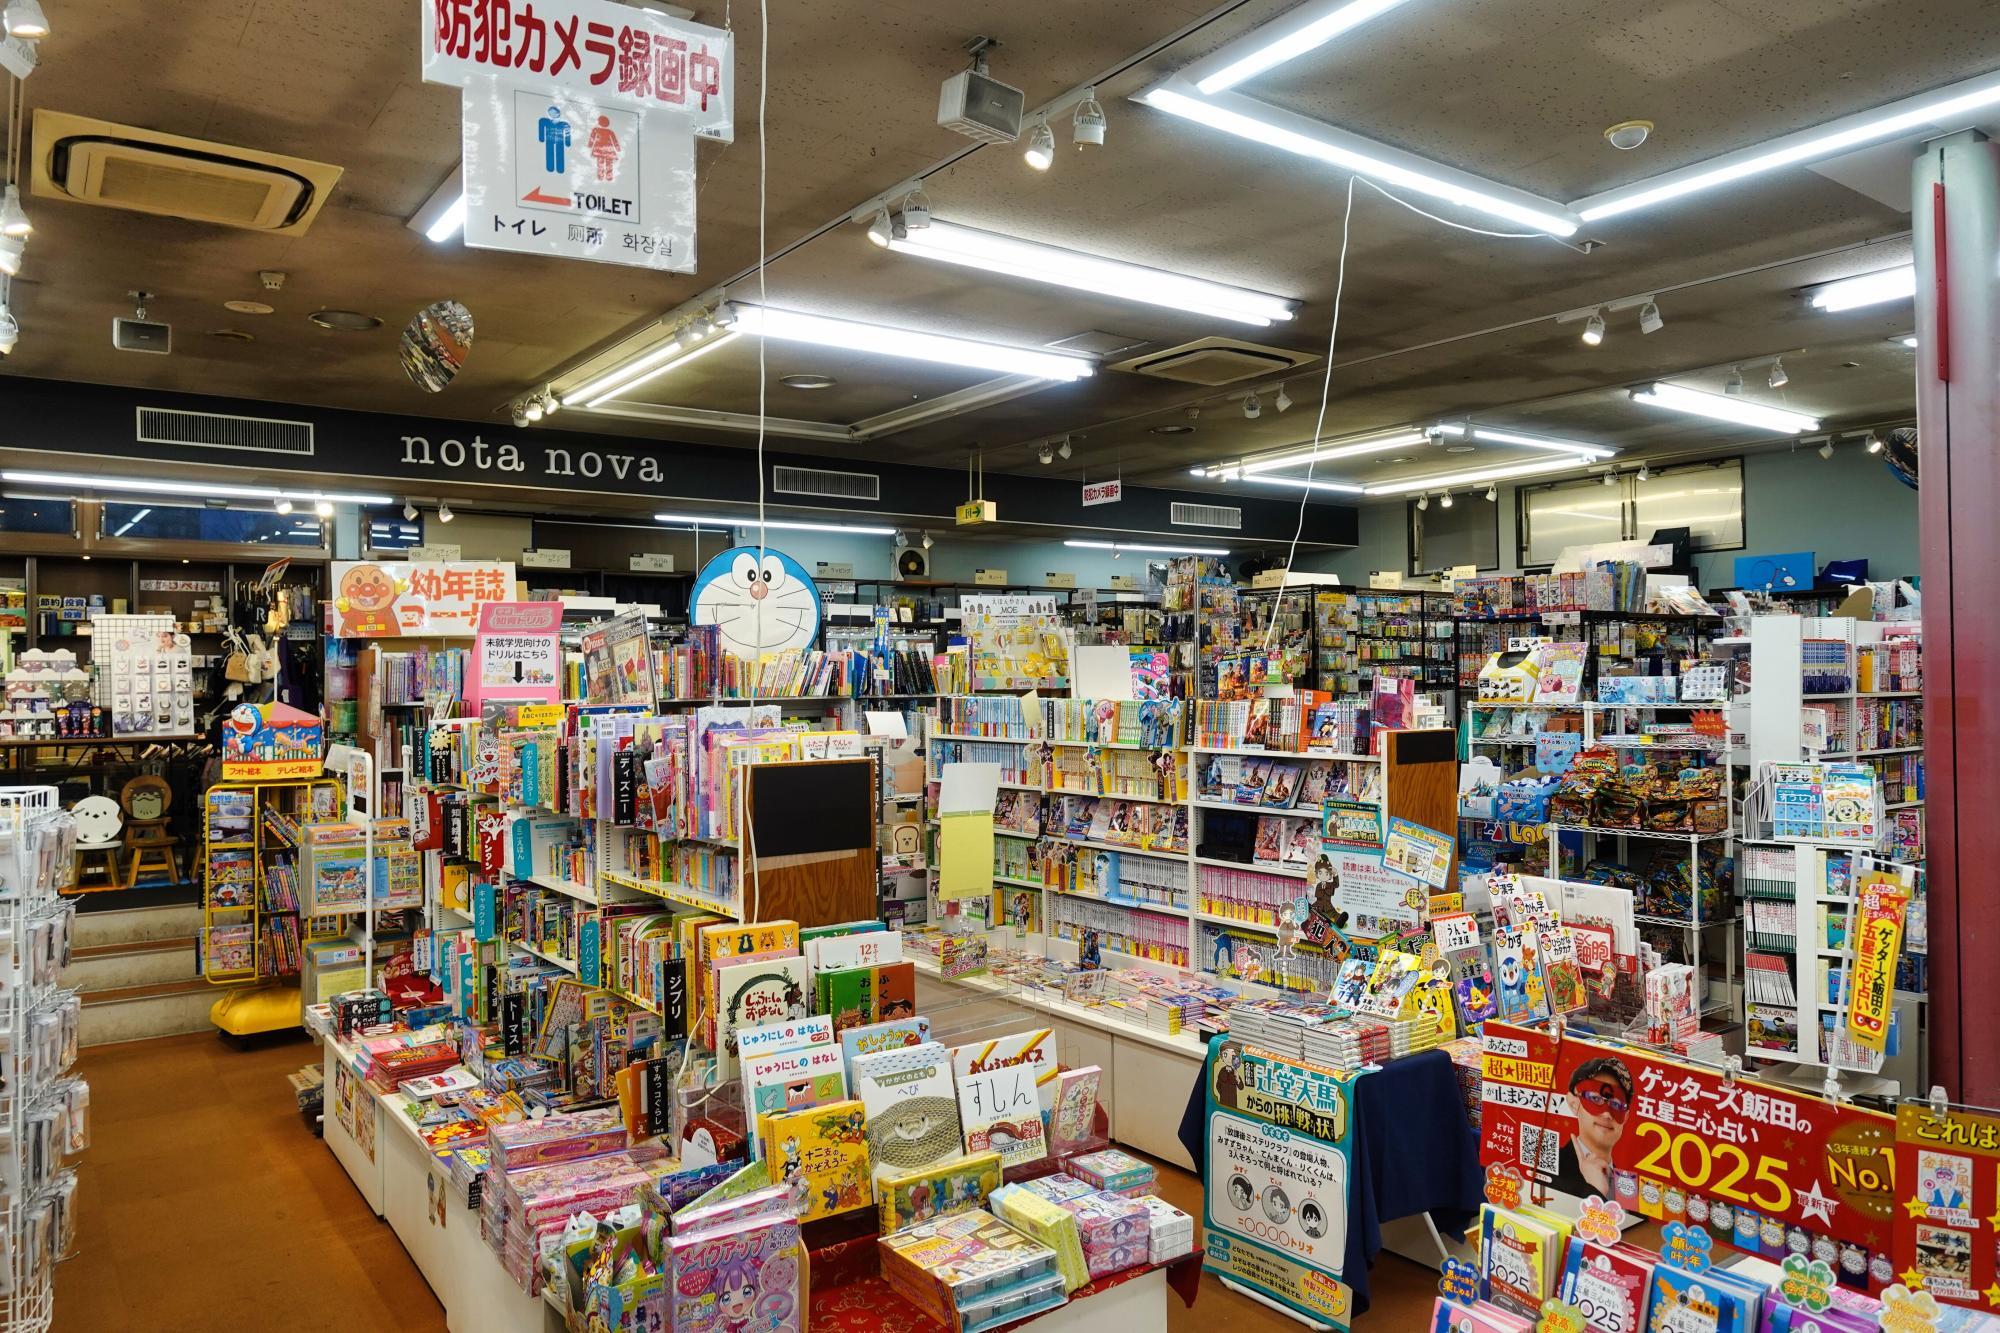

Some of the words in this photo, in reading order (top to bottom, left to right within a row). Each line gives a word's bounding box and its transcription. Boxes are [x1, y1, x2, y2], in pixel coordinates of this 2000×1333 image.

[434, 0, 720, 112] 防犯カメラ録画中
[573, 192, 632, 217] TOILET
[493, 214, 547, 237] トイレ
[621, 232, 673, 257] 화장실
[400, 435, 525, 472] nota
[544, 448, 664, 483] nova
[1083, 482, 1120, 501] 防犯カメラ録画中
[409, 568, 505, 602] 幼年誌
[39, 597, 61, 608] 節約
[64, 597, 86, 609] 投資
[991, 597, 1026, 606] えほんやさん
[1000, 606, 1018, 614] MOE
[62, 609, 84, 620] 投資
[485, 638, 551, 648] 未就学児向けの
[487, 650, 549, 660] ドリルはこちら
[228, 766, 262, 776] フォト絵本
[276, 765, 314, 775] テレビ絵本
[472, 765, 499, 781] ノンタン
[525, 748, 534, 798] ポケットモンスター
[619, 757, 630, 814] ディズニー
[516, 825, 525, 861] ミニえほん
[484, 837, 492, 871] ノンタン
[1342, 861, 1390, 876] 読書は楽しい。
[1499, 883, 1514, 895] 漢字
[1870, 884, 1895, 893] あなたの
[478, 890, 487, 934] キャラクター
[1524, 900, 1545, 914] かん字
[1310, 920, 1325, 941] 犯
[1447, 922, 1468, 935] うんこ
[1538, 920, 1559, 933] かん字
[859, 943, 872, 956] 12
[1551, 935, 1572, 948] ひらがな
[1553, 944, 1572, 956] カタカナ
[584, 927, 594, 982] アンパンマン
[1460, 963, 1482, 978] 全漢字
[1856, 924, 1878, 1011] 五星三心占い
[1870, 927, 1893, 1017] ゲッターズ飯田の
[667, 974, 682, 1021] ジブリ
[745, 1004, 784, 1021] おはなし
[508, 1001, 520, 1047] トーマス
[614, 1028, 627, 1036] 10
[742, 1028, 794, 1047] じゅうにしの
[797, 1023, 830, 1038] はなしの
[856, 1028, 918, 1052] おしょうがつ
[1487, 1037, 1526, 1054] あなたの
[754, 1057, 809, 1077] じゅうにしの
[811, 1051, 838, 1066] はなし
[969, 1048, 1045, 1075] おしょうがつバス
[885, 1069, 926, 1087] かがくのとも
[652, 1064, 662, 1125] すみっコぐらし
[897, 1083, 919, 1097] へび
[965, 1073, 1032, 1117] すしん
[1485, 1085, 1567, 1114] が止まらない!
[1636, 1065, 1813, 1135] ゲッターズ飯田の
[1246, 1094, 1273, 1115] からの
[1275, 1103, 1335, 1141] 挑戦状
[1496, 1122, 1515, 1134] まずは
[1636, 1094, 1760, 1145] 五星三心占い
[1492, 1131, 1515, 1145] タイプを
[1916, 1114, 1999, 1150] これは
[804, 1146, 840, 1159] 十二支の
[1217, 1135, 1338, 1183] みすずちゃん・てんまくん・りくくんは、
[1832, 1143, 1871, 1157] 3年連続
[804, 1152, 849, 1174] かぞえうた
[1228, 1149, 1323, 1189] 3人そろって何と呼ばれている?
[1635, 1121, 1792, 1213] 2025
[1826, 1146, 1896, 1192] No.1
[1921, 1154, 1968, 1174] 金持ち
[1489, 1175, 1516, 1192] モテ期
[1617, 1181, 1635, 1192] 2025
[1797, 1194, 1837, 1216] 最新刊
[1949, 1218, 1978, 1227] なりたい
[679, 1230, 769, 1273] メイクアップ
[1669, 1250, 1702, 1268] 叶う年
[1489, 1258, 1531, 1294] 2025
